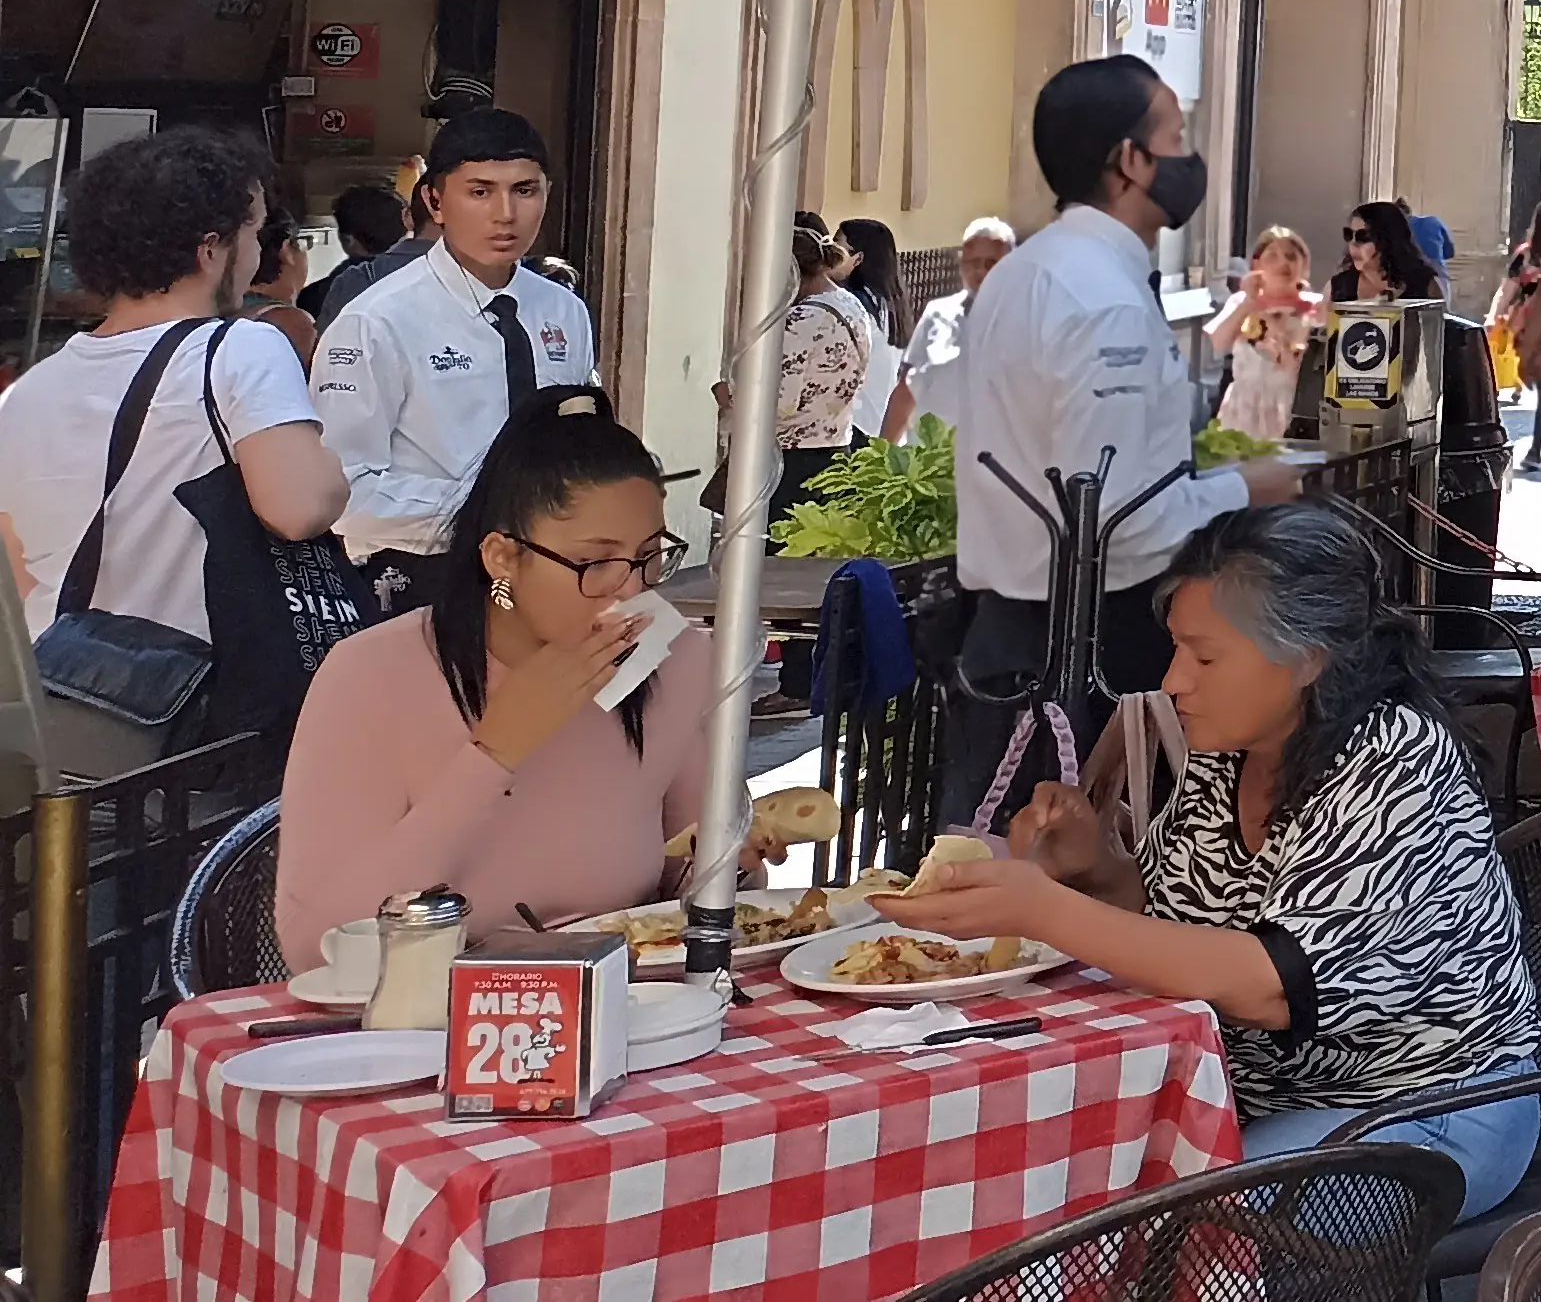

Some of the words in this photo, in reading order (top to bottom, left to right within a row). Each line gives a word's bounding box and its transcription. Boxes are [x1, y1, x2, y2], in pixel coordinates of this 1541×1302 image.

[499, 973, 542, 981] HORARIO
[467, 992, 563, 1016] MESA
[465, 1022, 533, 1085] 28
